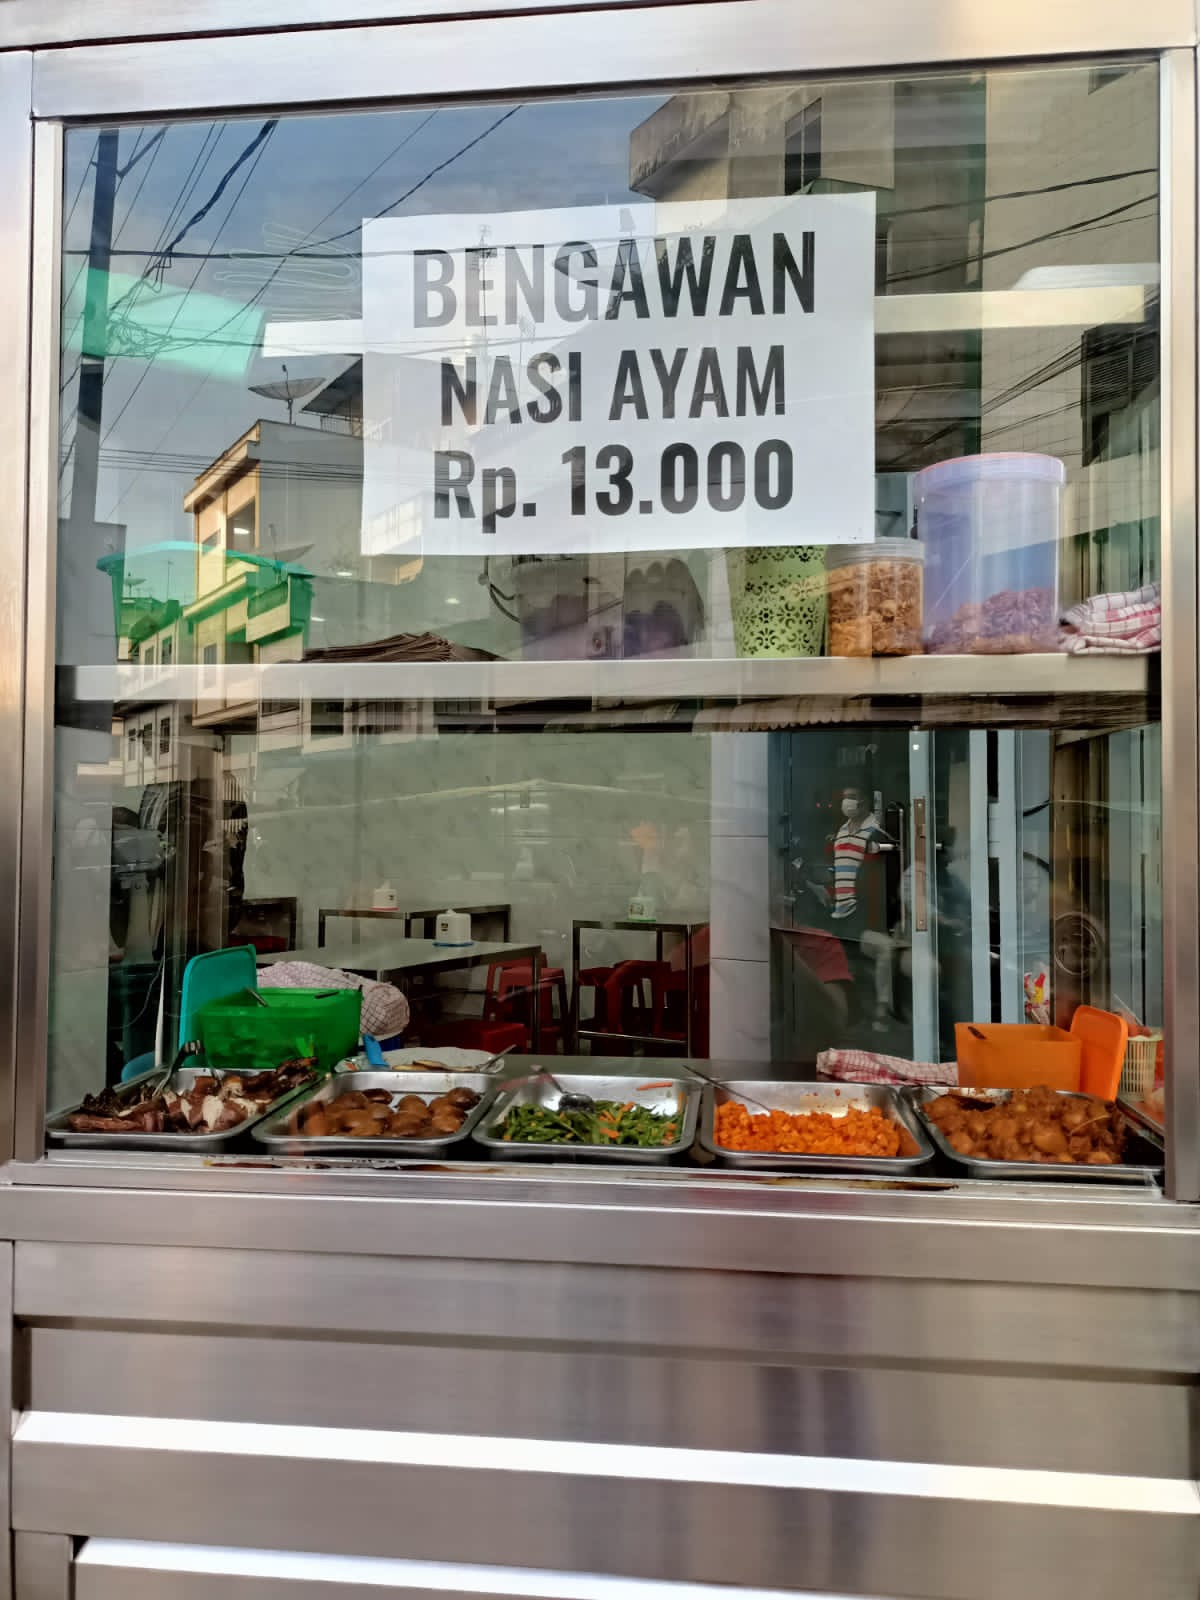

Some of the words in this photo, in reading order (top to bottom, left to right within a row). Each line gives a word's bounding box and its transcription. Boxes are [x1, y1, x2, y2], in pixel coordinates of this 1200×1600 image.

[413, 231, 816, 328] BENGAWAN
[440, 350, 583, 427] NASI
[608, 344, 786, 421] AYAM
[434, 449, 537, 534] Rp.
[561, 438, 794, 517] 13.000
